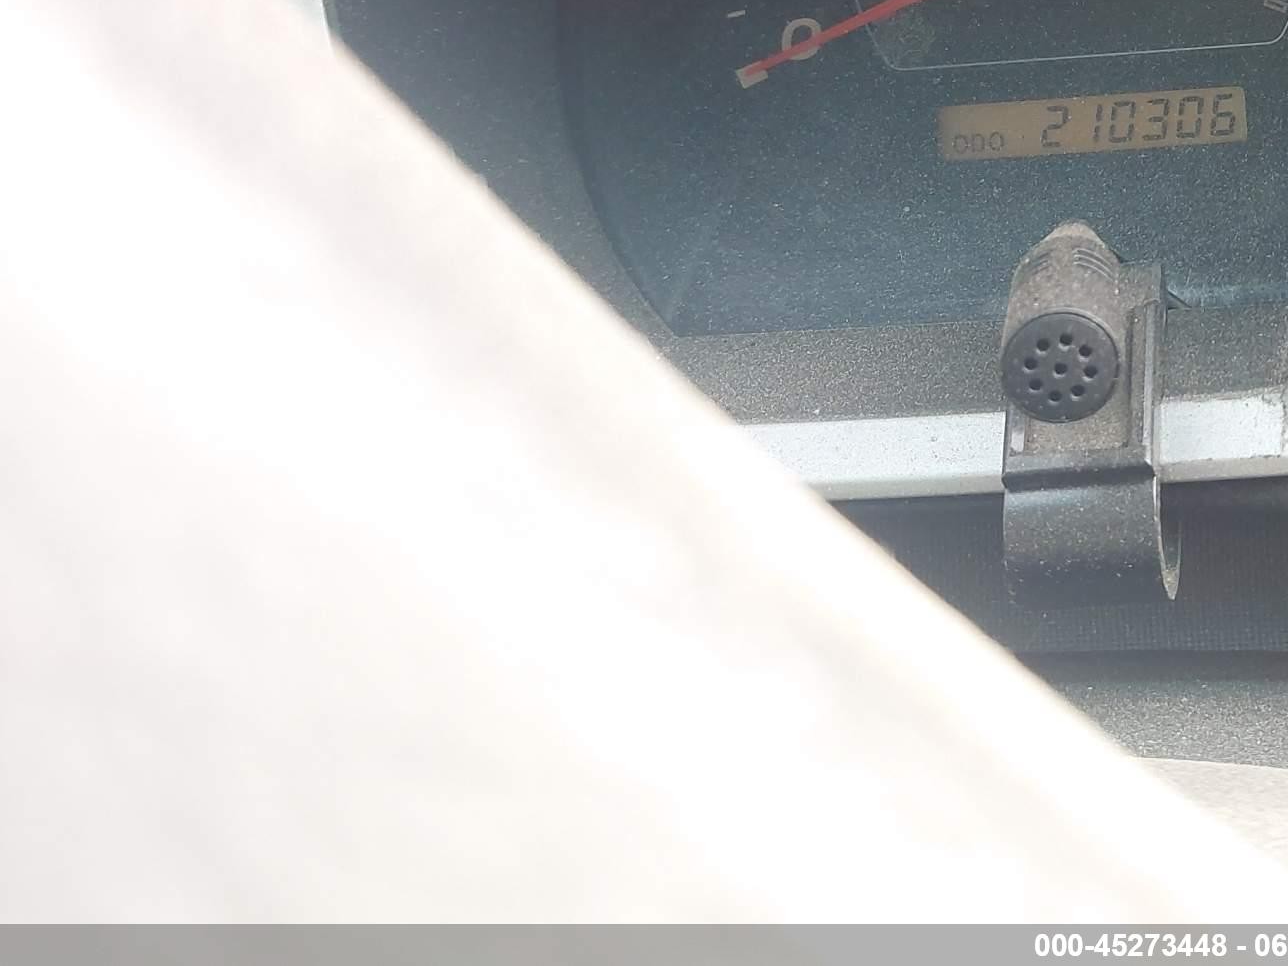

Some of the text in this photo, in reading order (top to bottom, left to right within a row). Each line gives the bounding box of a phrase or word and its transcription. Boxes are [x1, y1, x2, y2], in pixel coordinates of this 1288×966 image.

[781, 18, 821, 60] 0
[952, 94, 1236, 154] ODO 210306
